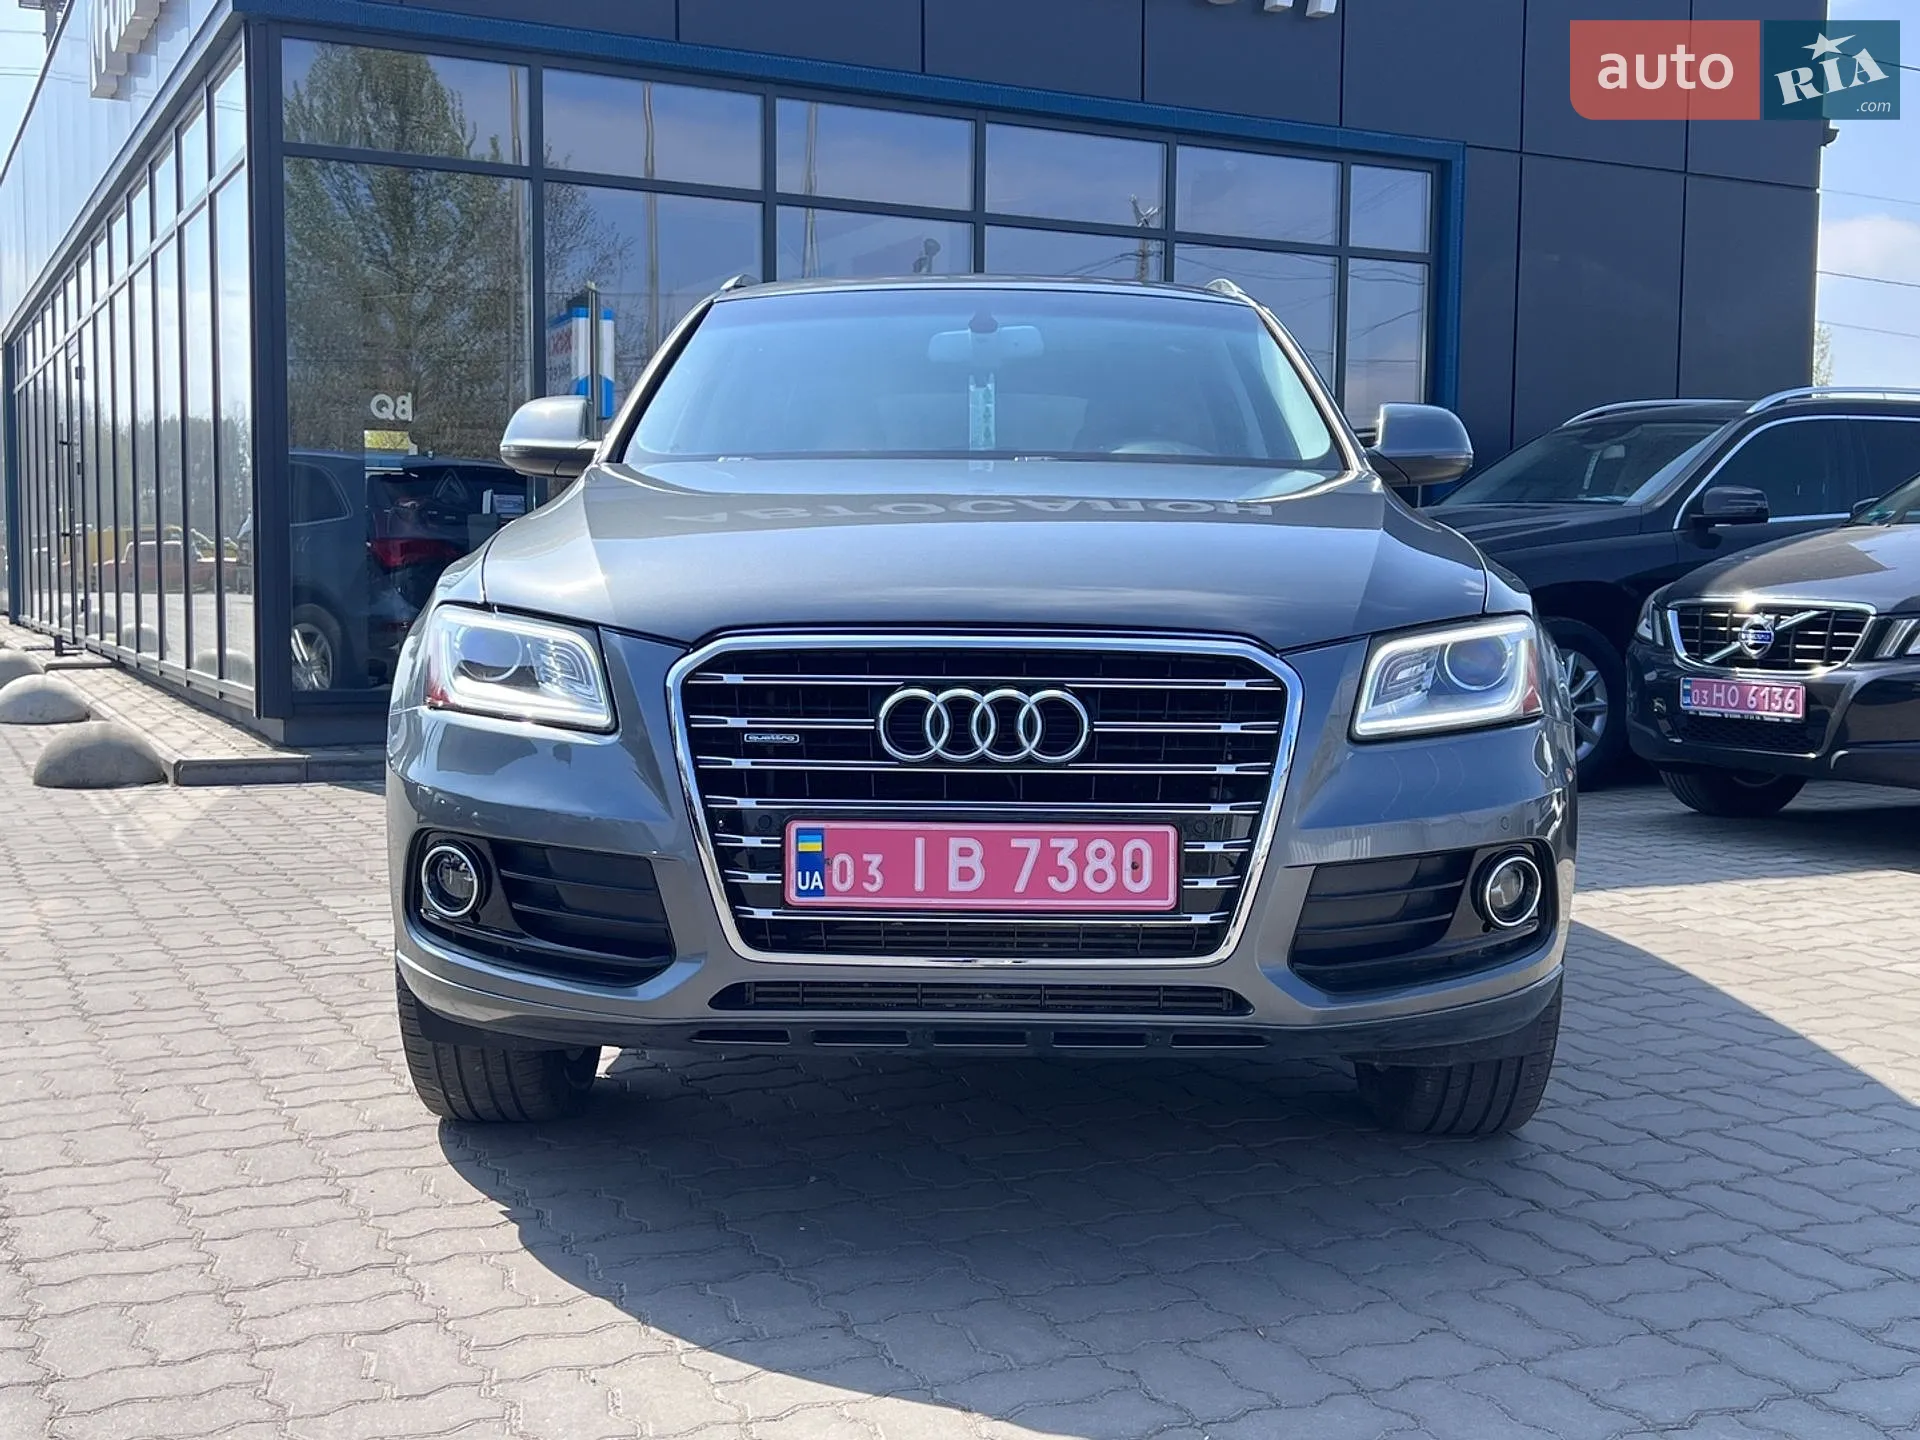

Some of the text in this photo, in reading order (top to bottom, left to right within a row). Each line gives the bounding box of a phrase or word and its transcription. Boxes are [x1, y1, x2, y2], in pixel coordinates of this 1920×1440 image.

[1691, 688, 1709, 705] 03
[1746, 685, 1796, 711] 6136
[831, 852, 884, 893] 03
[1009, 837, 1154, 893] 7380
[797, 870, 824, 891] UA
